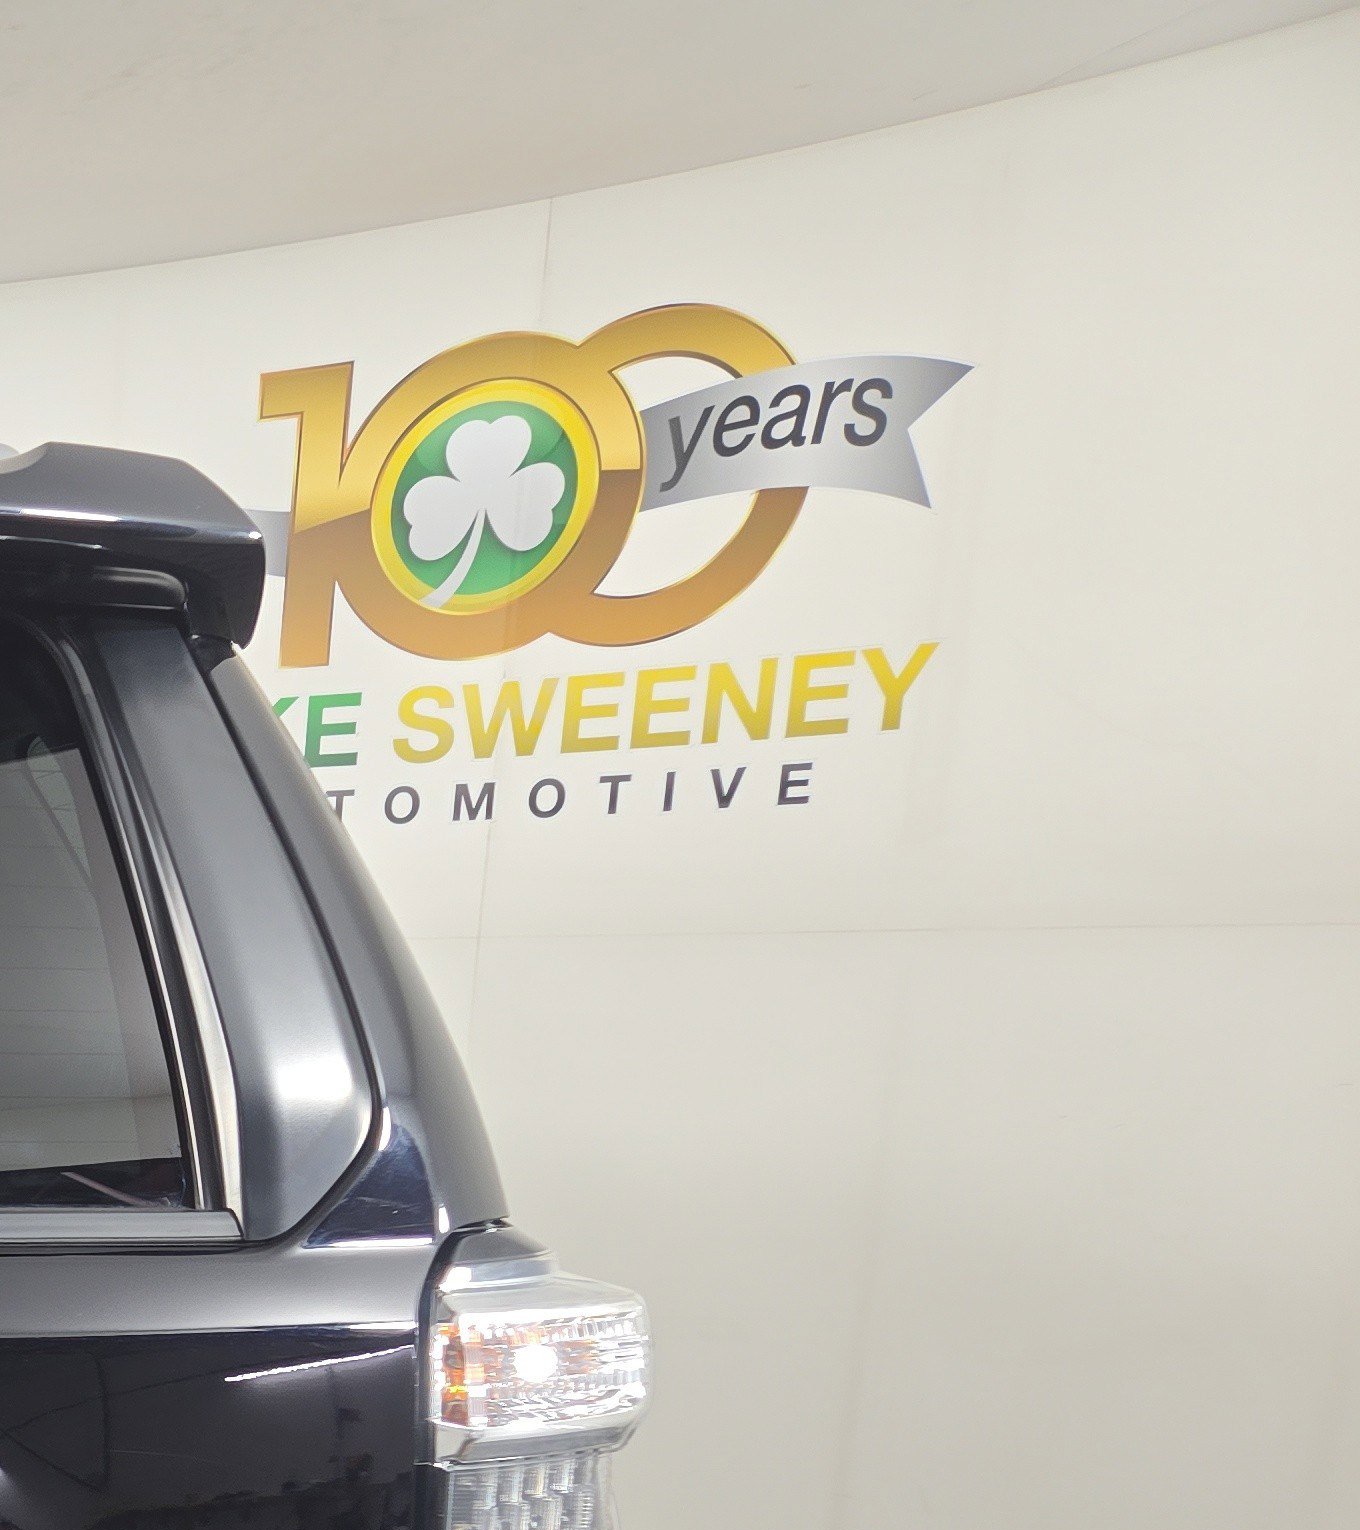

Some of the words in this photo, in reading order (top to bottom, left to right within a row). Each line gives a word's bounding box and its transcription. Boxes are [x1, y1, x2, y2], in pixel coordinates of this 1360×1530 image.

[259, 302, 810, 668] 100
[659, 375, 894, 491] years
[392, 641, 939, 764] SWEENEY
